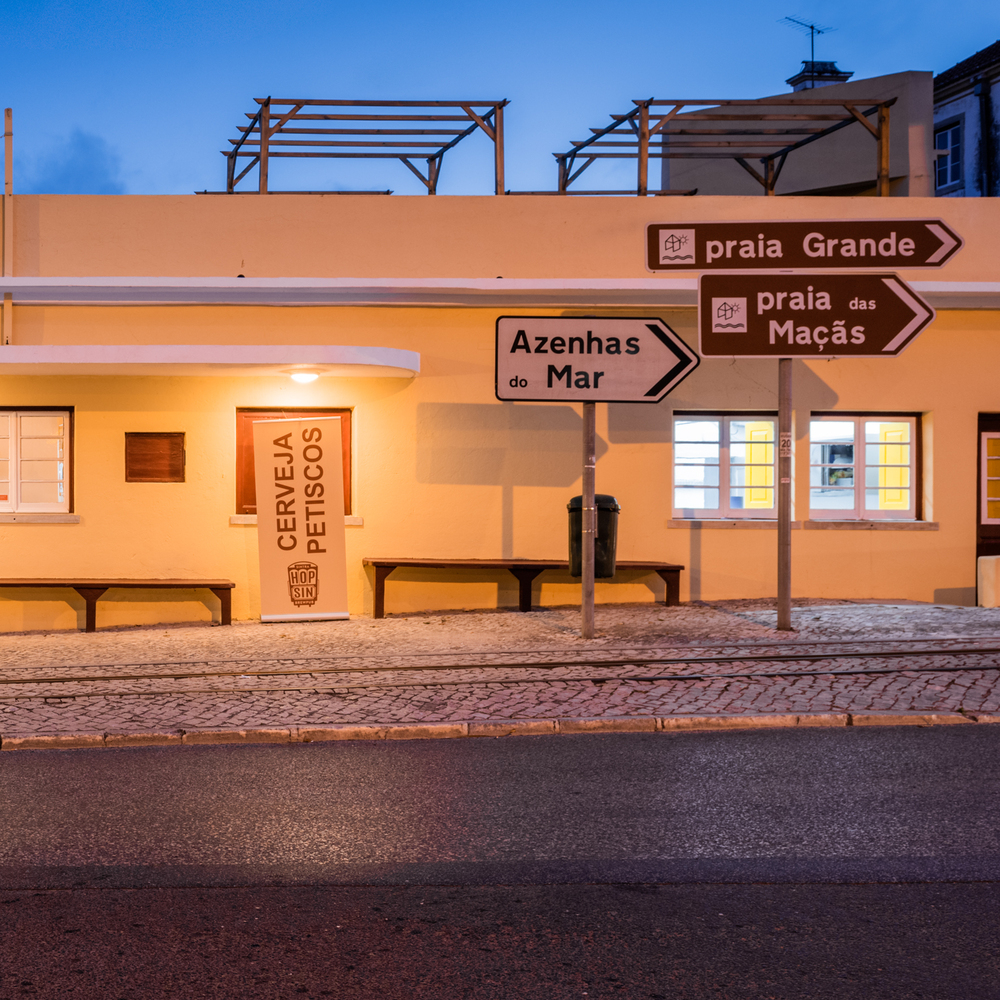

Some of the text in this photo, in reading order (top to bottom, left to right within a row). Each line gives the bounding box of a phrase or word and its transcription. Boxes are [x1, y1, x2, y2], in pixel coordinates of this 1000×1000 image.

[706, 232, 915, 263] praia Grande
[758, 286, 876, 314] praia das
[510, 330, 639, 354] Azenhas
[770, 320, 865, 351] Maçãs
[509, 365, 604, 389] do Mar
[273, 432, 297, 551] CERVEJA
[302, 427, 326, 553] PETISCOS
[291, 571, 315, 584] HOP
[294, 587, 313, 598] SIN
